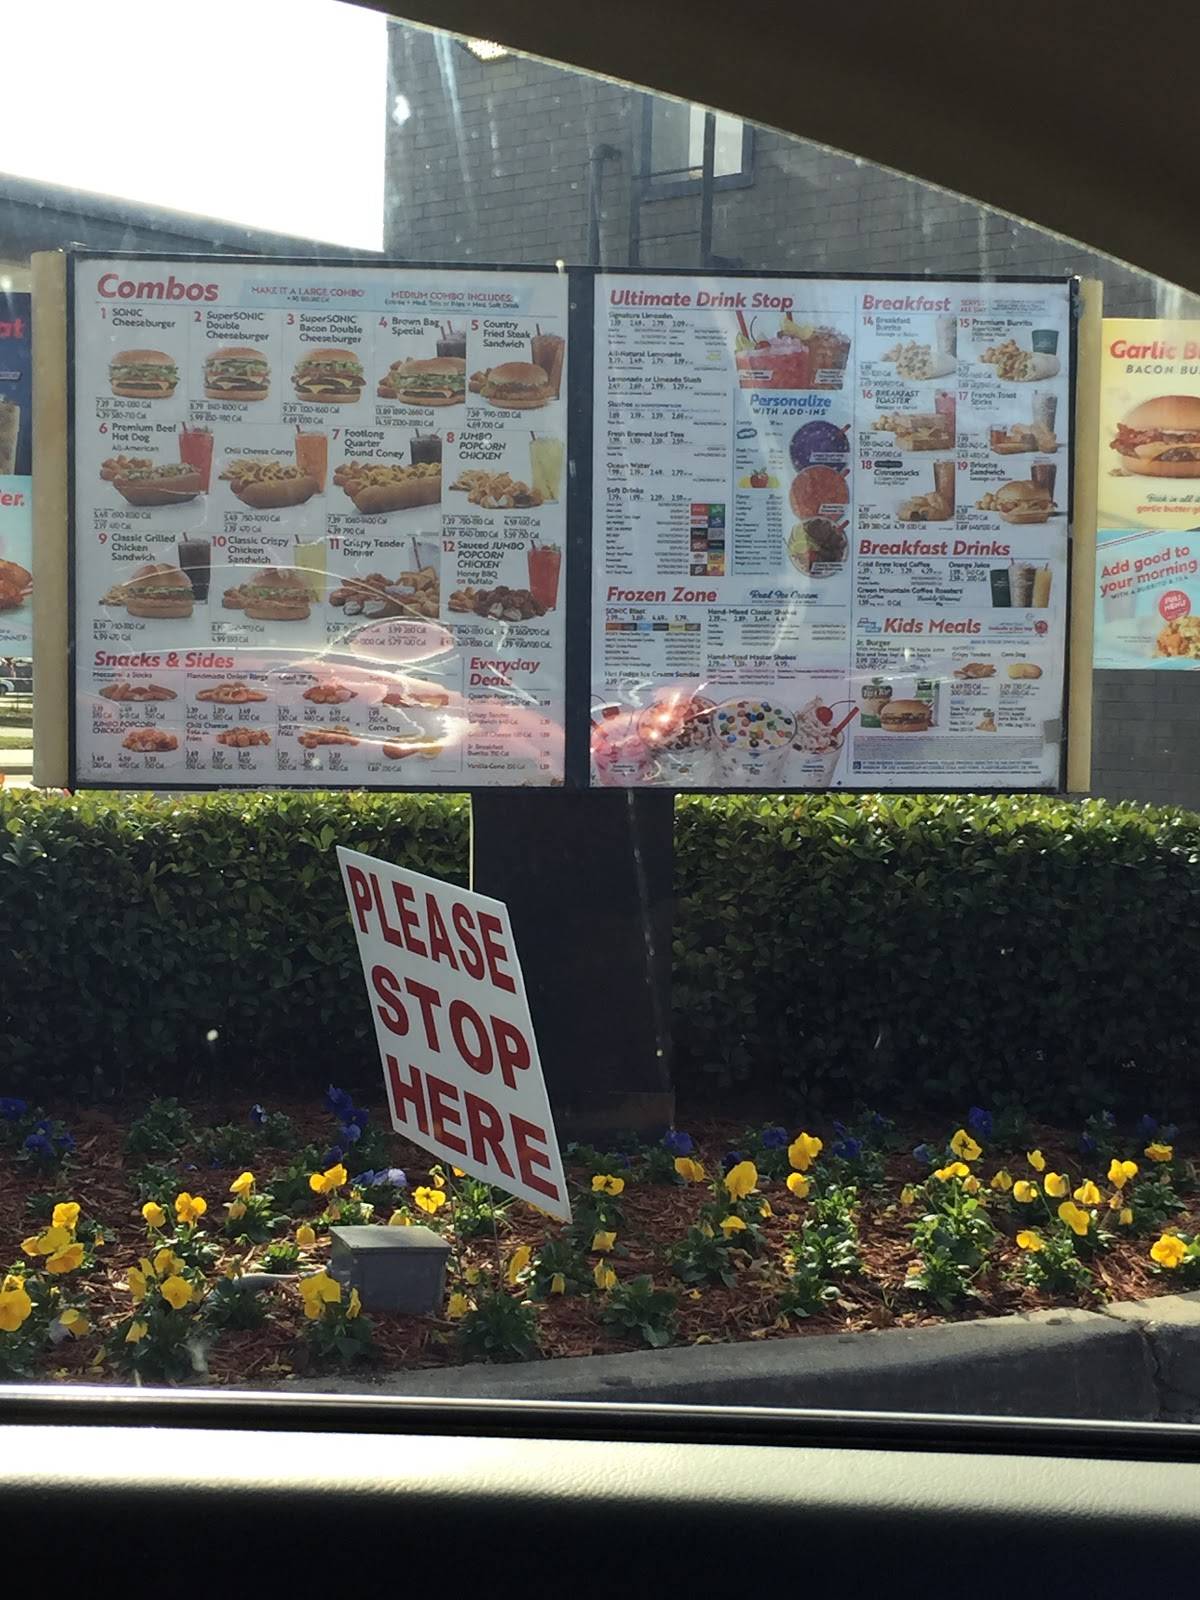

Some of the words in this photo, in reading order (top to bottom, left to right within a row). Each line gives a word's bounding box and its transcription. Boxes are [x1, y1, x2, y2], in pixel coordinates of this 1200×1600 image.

[97, 272, 219, 301] Combos
[298, 288, 329, 296] LARGE
[330, 288, 365, 297] COMBO
[391, 291, 428, 299] MEDIUM
[430, 292, 464, 300] COMBO
[610, 289, 691, 307] Ultimate
[696, 292, 747, 307] Drink
[751, 292, 794, 312] Stop
[862, 294, 951, 312] Breakfast
[100, 308, 106, 319] 1
[112, 308, 143, 317] SONIC
[194, 311, 201, 322] 2
[206, 312, 265, 322] SuperSONIC
[287, 313, 295, 325] 3
[300, 314, 357, 324] SuperSONIC
[112, 318, 176, 329] Cheeseburger
[206, 321, 240, 330] Double
[378, 316, 388, 328] 4
[392, 317, 421, 326] Brown
[423, 318, 440, 328] Bag
[471, 320, 479, 331] 5
[483, 320, 519, 330] Country
[863, 316, 874, 326] 14
[876, 316, 911, 324] Breakfast
[960, 318, 970, 328] 15
[300, 324, 327, 333] Bacon
[330, 324, 363, 334] Double
[392, 327, 424, 336] Special
[483, 330, 505, 338] Fried
[507, 330, 531, 339] Steak
[206, 331, 269, 342] Cheeseburger
[299, 333, 362, 345] Cheeseburger
[483, 339, 525, 349] Sandwich
[1110, 340, 1176, 360] Garlic
[1126, 364, 1174, 375] BACON
[862, 390, 873, 399] 16
[958, 391, 968, 400] 17
[750, 394, 832, 407] Personalize
[753, 407, 778, 415] WITH
[782, 408, 827, 416] ADD-INS
[99, 422, 108, 434] 6
[112, 423, 154, 432] Premium
[156, 423, 177, 432] Beef
[112, 433, 129, 441] Hot
[131, 433, 150, 443] Dog
[332, 429, 340, 440] 7
[344, 429, 385, 440] Footlong
[446, 431, 455, 443] 8
[459, 432, 492, 440] JUMBO
[344, 439, 381, 449] Quarter
[459, 442, 506, 450] POPCORN
[344, 449, 373, 457] Pound
[376, 449, 404, 459] Coney
[459, 451, 502, 460] CHICKEN
[861, 460, 872, 469] 18
[957, 461, 968, 470] 19
[970, 461, 997, 469] Brioche
[98, 533, 107, 544] 9
[111, 533, 142, 542] Classic
[144, 534, 176, 543] Grilled
[212, 536, 227, 547] 10
[228, 536, 258, 544] Classic
[260, 537, 289, 547] Crispy
[329, 538, 340, 550] 11
[343, 539, 371, 549] Crispy
[374, 539, 405, 548] Tender
[111, 543, 148, 551] Chicken
[228, 546, 264, 554] Chicken
[443, 541, 455, 552] 12
[457, 541, 489, 549] Sauced
[492, 542, 525, 550] JUMBO
[858, 539, 948, 555] Breakfast
[952, 541, 1011, 556] Drinks
[111, 553, 156, 561] Sandwich
[343, 548, 374, 557] Dinner
[457, 551, 504, 559] POPCORN
[228, 555, 271, 564] Sandwich
[457, 560, 500, 568] CHICKEN
[1101, 560, 1130, 579] Add
[1134, 548, 1171, 572] good
[1175, 545, 1190, 557] to
[948, 562, 972, 570] Orange
[457, 570, 480, 578] Honey
[481, 570, 498, 579] BBQ
[1099, 577, 1133, 598] your
[1137, 560, 1198, 584] morning
[607, 586, 666, 602] Frozen
[671, 587, 718, 602] Zone
[884, 618, 923, 634] Kids
[928, 619, 981, 634] Meals
[94, 651, 161, 667] Snacks
[166, 651, 179, 667] &
[185, 652, 234, 669] Sides
[470, 657, 541, 674] Everyday
[346, 864, 516, 995] PLEASE
[371, 964, 531, 1090] STOP
[385, 1054, 560, 1202] HERE
